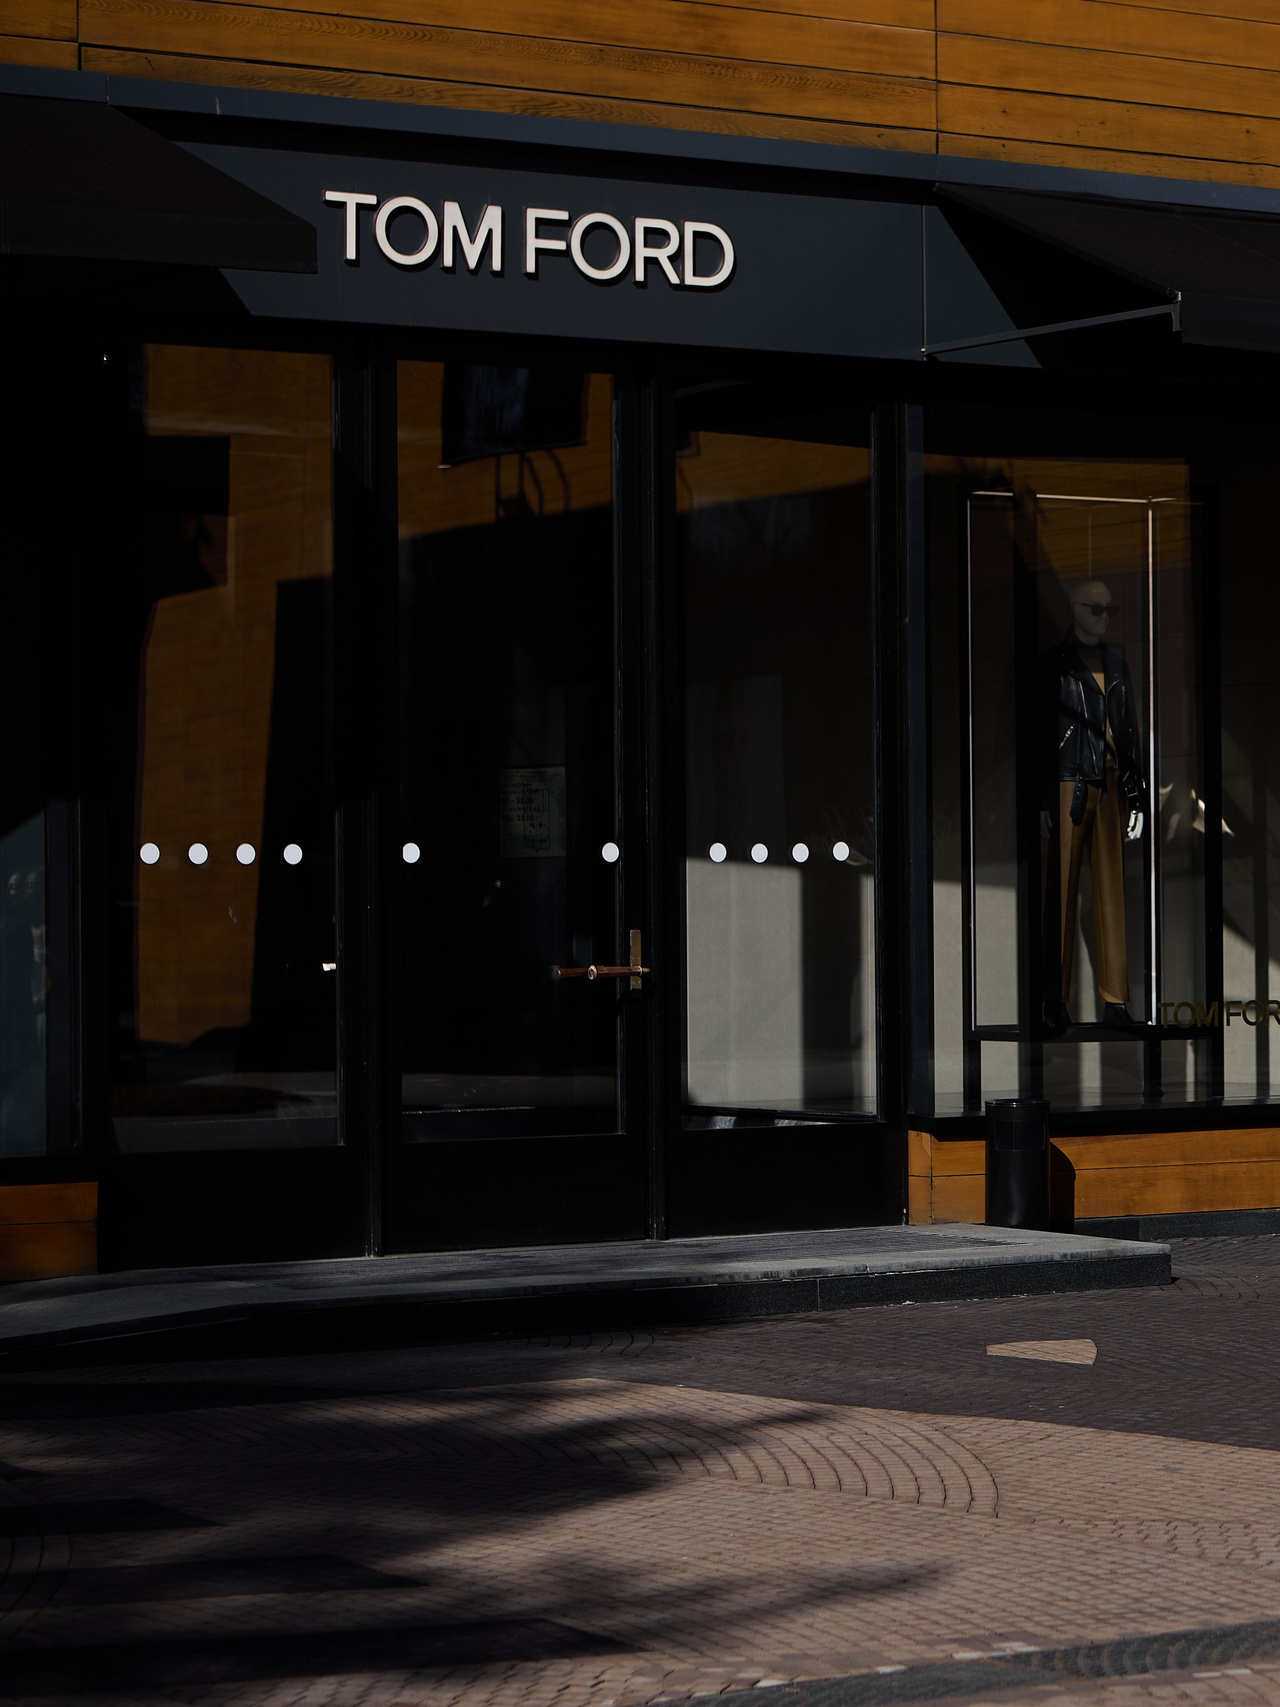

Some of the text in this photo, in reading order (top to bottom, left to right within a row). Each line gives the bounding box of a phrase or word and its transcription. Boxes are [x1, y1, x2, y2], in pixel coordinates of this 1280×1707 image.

[323, 190, 736, 289] TOM FORD
[1157, 1001, 1219, 1029] TOM
